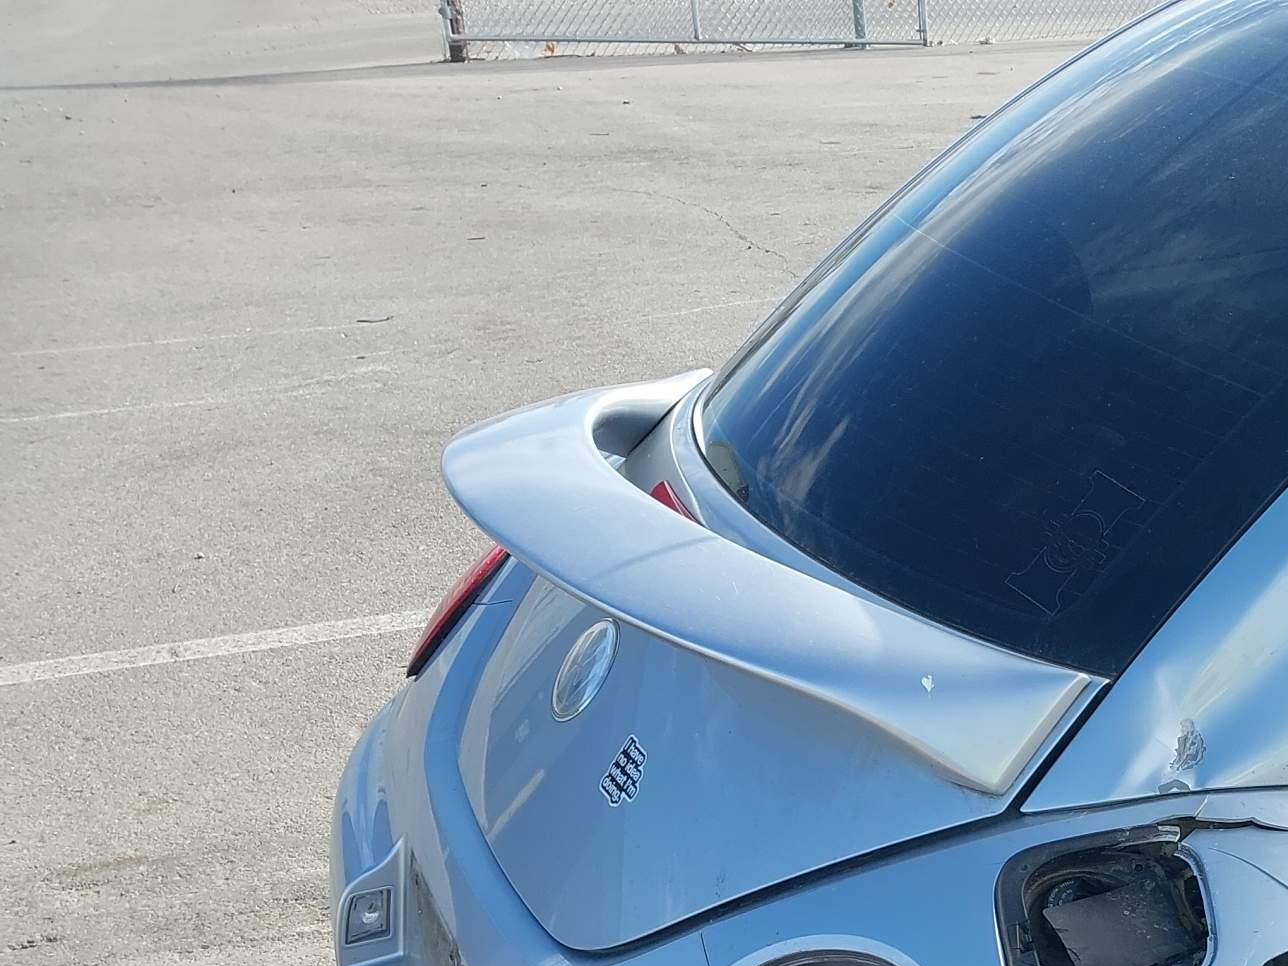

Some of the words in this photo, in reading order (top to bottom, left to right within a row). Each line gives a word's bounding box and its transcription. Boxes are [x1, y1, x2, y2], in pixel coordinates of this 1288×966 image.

[617, 754, 627, 766] no
[627, 743, 643, 764] have
[611, 765, 627, 786] what
